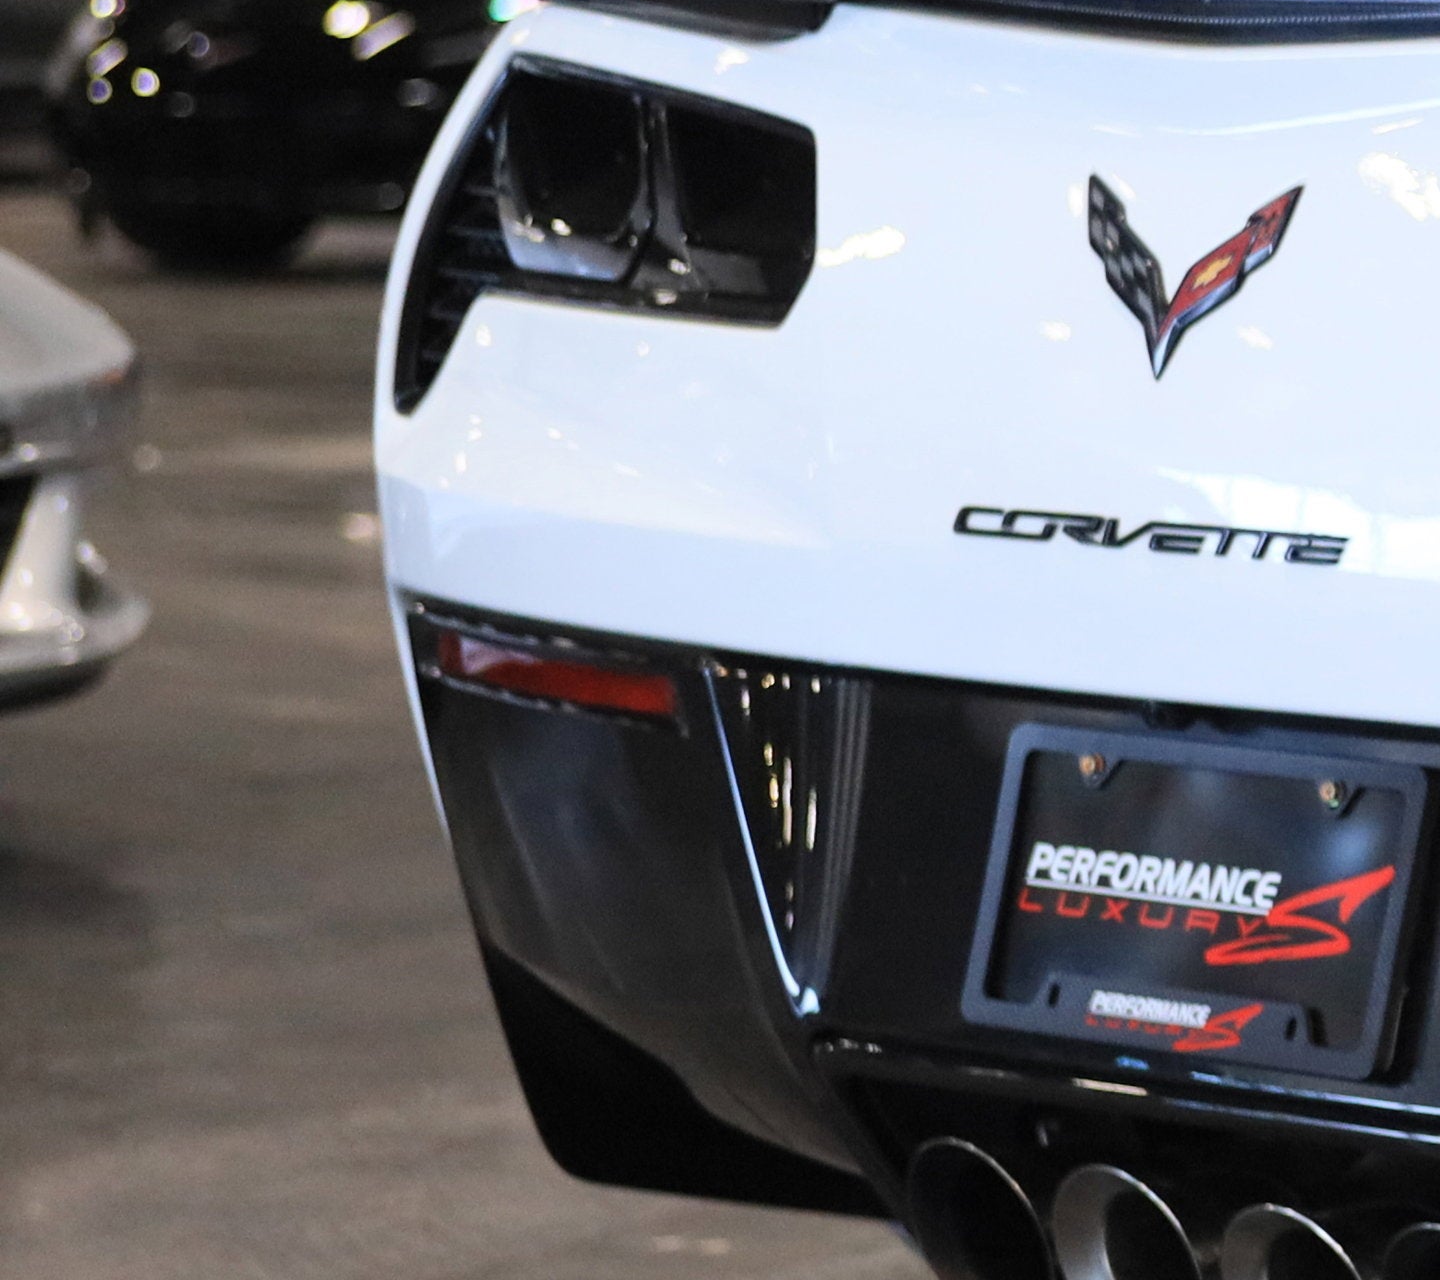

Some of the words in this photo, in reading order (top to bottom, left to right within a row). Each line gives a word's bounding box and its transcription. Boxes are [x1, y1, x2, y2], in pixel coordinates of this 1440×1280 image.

[953, 506, 1350, 565] CORVETTE
[1027, 841, 1282, 912] PERFORMANCE
[1017, 886, 1264, 938] LUXURY
[1089, 989, 1212, 1028] PERFORMANCE
